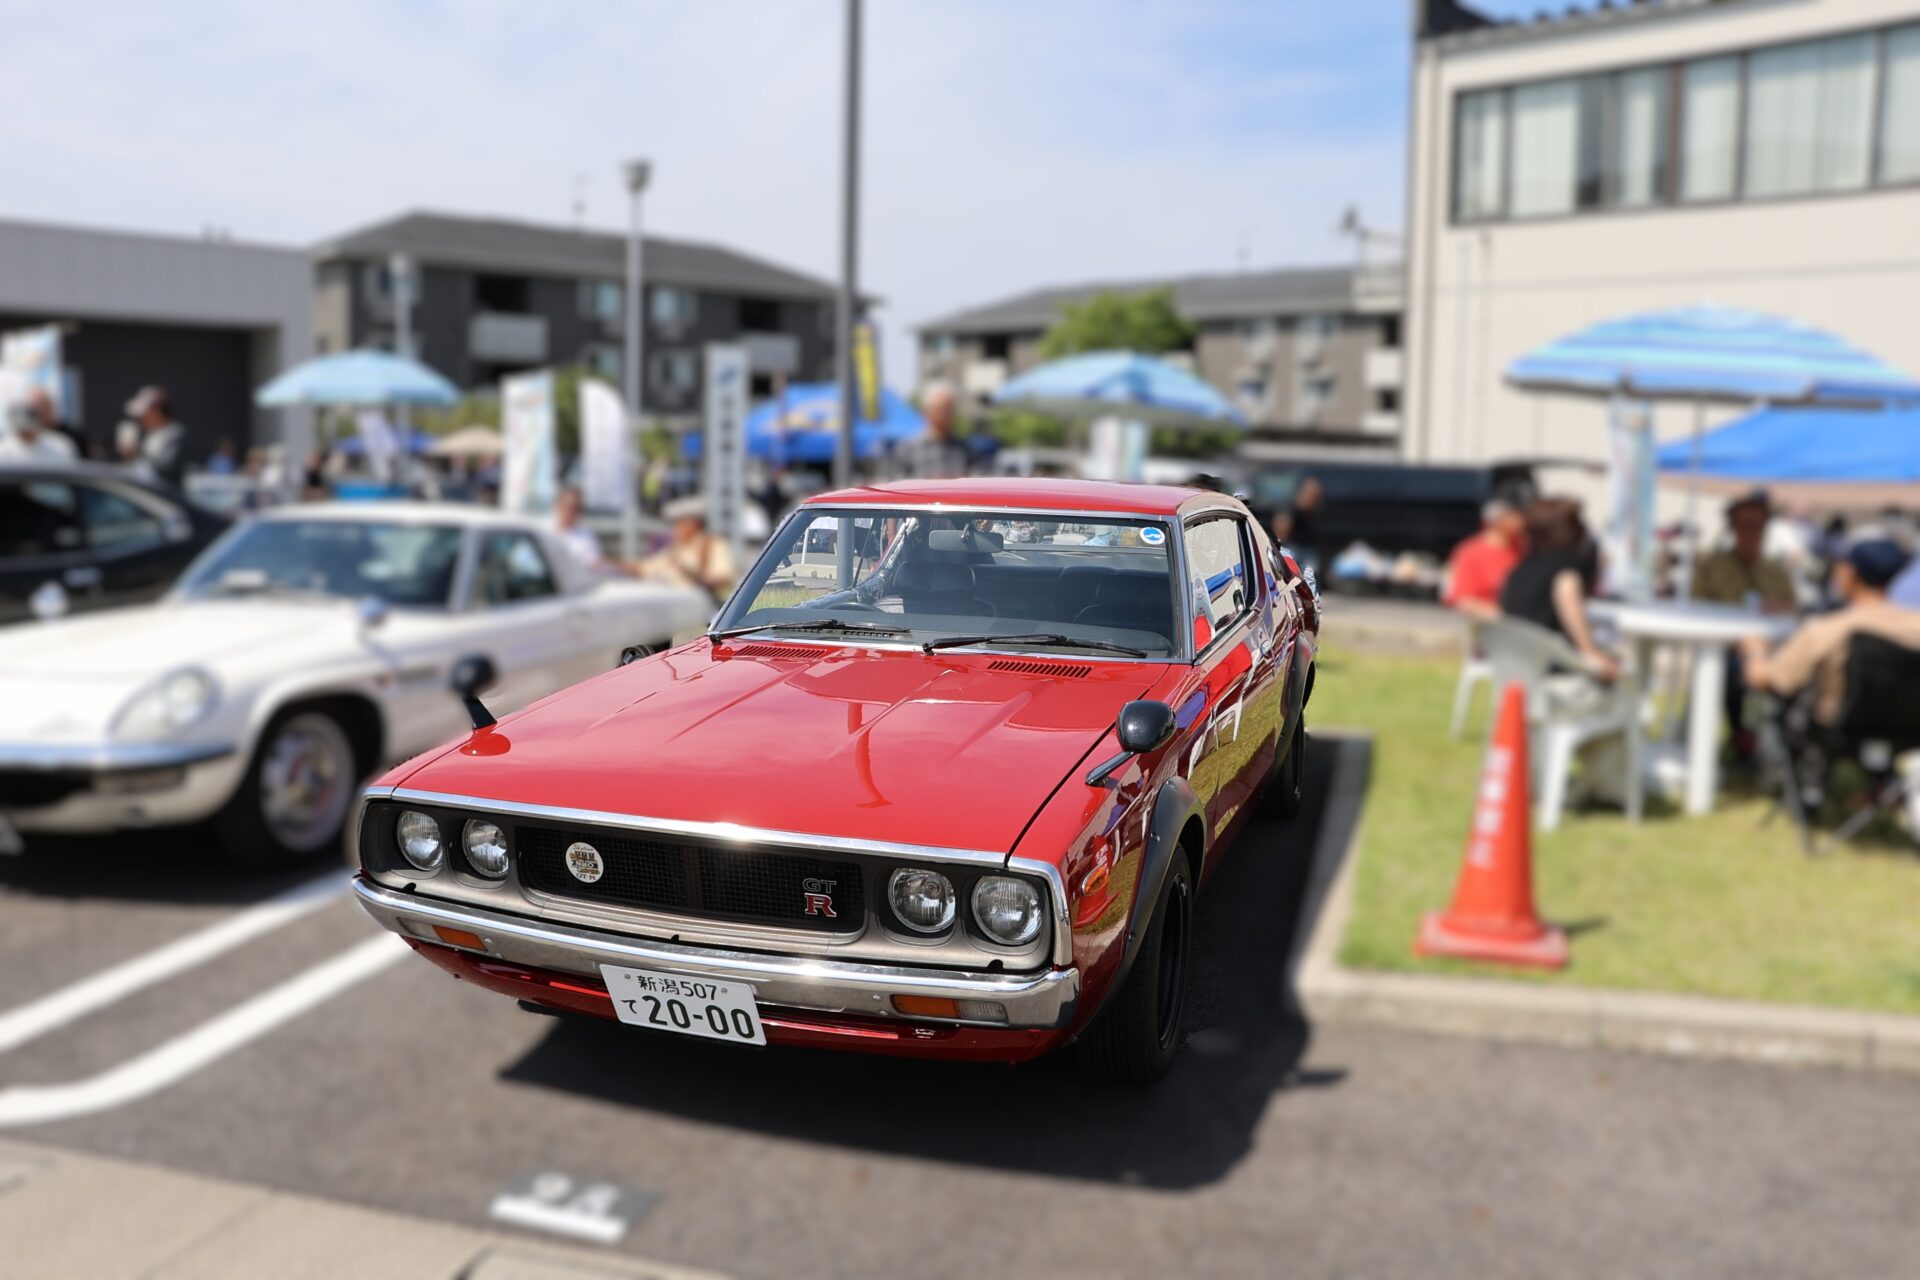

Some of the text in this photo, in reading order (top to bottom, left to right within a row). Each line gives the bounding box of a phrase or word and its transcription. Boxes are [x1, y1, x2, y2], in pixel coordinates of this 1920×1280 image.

[802, 877, 837, 894] GT
[803, 892, 837, 917] R
[620, 995, 755, 1039] て 20-00
